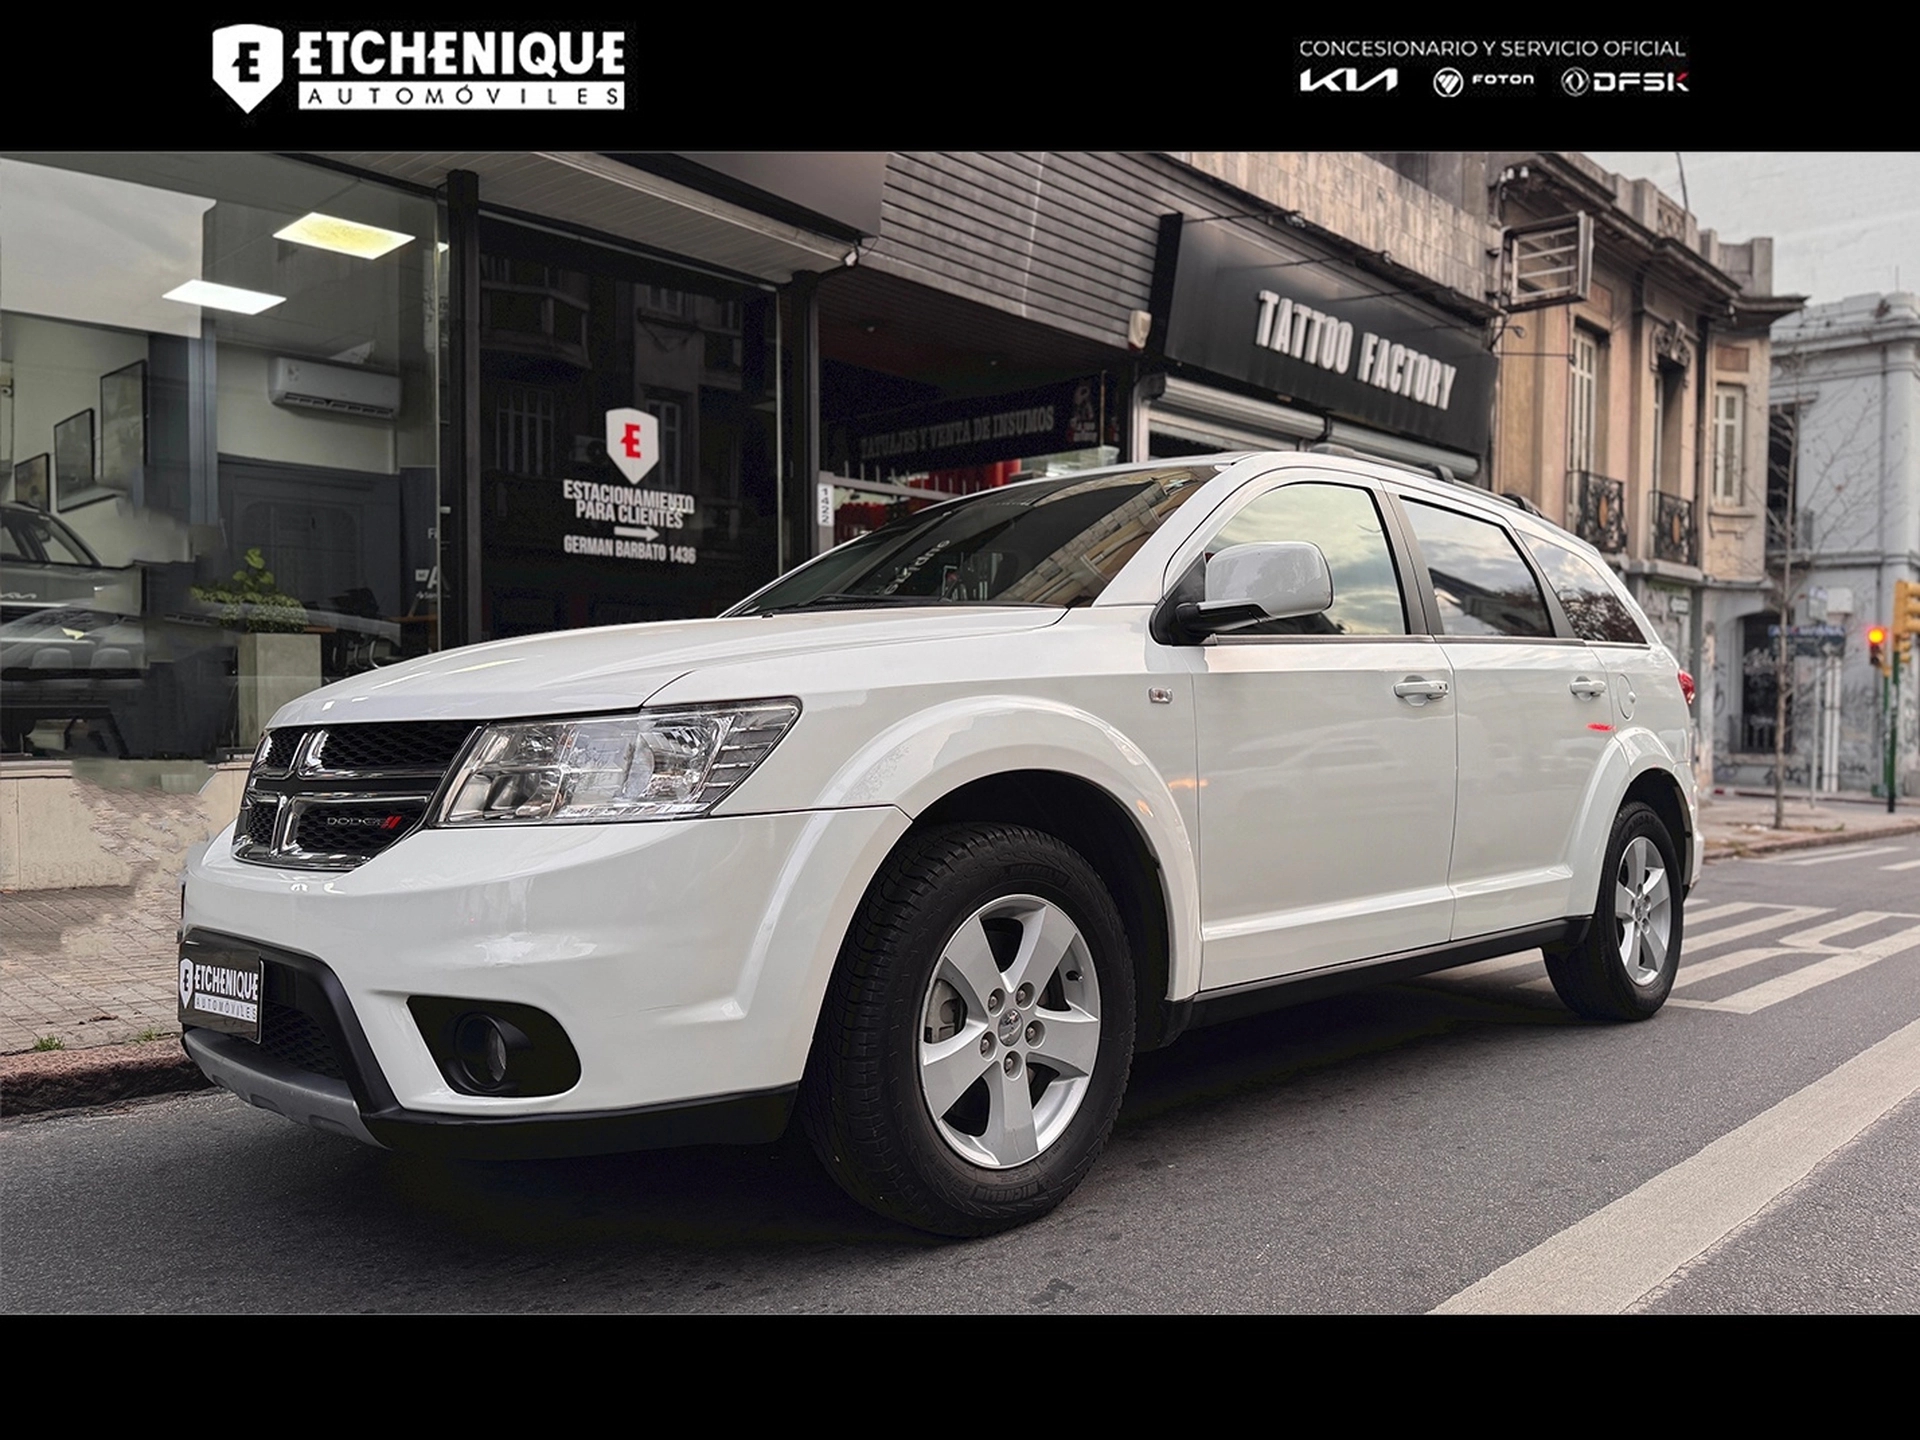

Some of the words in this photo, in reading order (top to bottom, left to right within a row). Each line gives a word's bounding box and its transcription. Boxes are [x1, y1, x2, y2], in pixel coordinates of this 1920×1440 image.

[1255, 289, 1354, 375] TATTOO
[1356, 332, 1457, 410] FACTORY
[563, 479, 695, 515] ESTACIONAMIENTO
[575, 500, 615, 523] PARA
[618, 504, 684, 530] CLIENTES
[820, 487, 830, 525] 1422
[563, 534, 613, 556] GERMAN
[615, 539, 667, 562] BARBATO
[669, 546, 697, 564] 1436
[194, 964, 258, 1001] ETCHENIQUE
[196, 996, 257, 1021] AUTOMÓVILES
